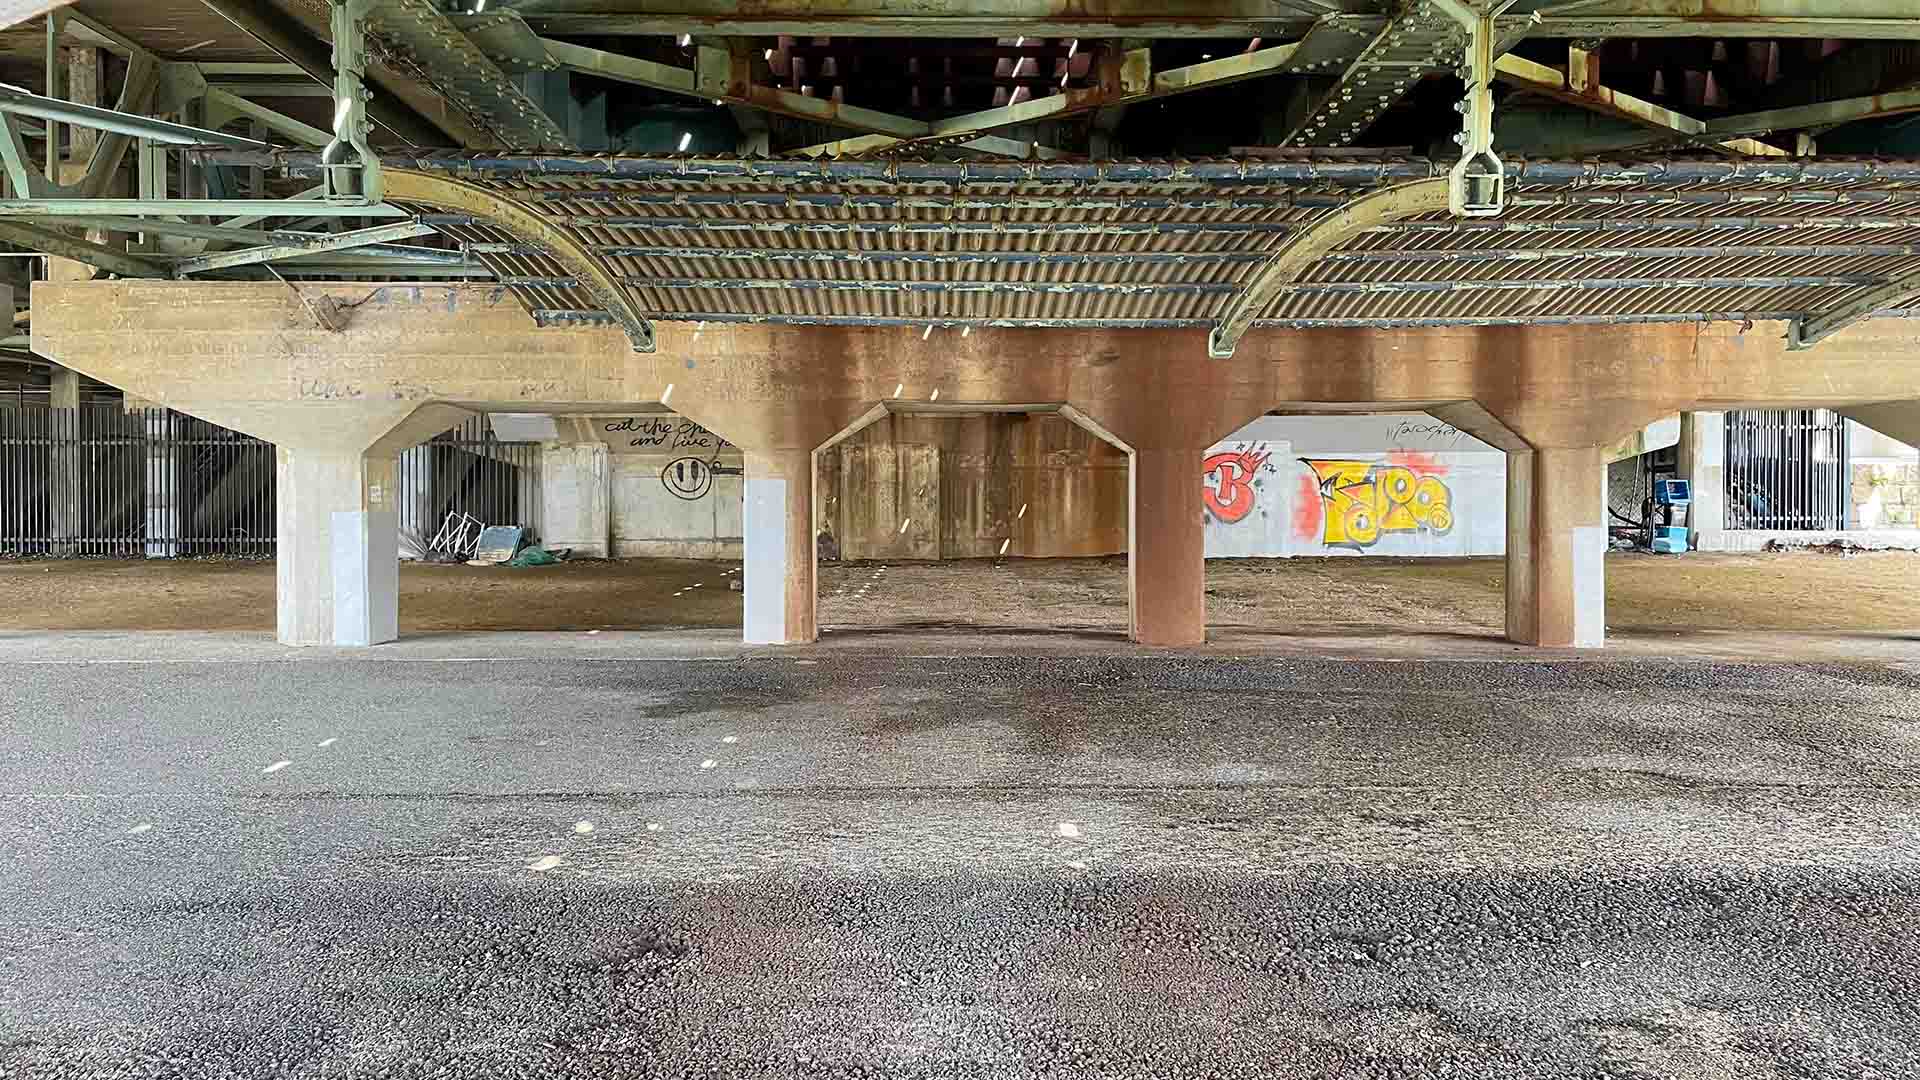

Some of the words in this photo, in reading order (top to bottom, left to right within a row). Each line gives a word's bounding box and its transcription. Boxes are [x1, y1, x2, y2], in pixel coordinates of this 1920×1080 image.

[639, 417, 673, 435] the
[630, 434, 667, 446] and
[672, 431, 711, 449] live
